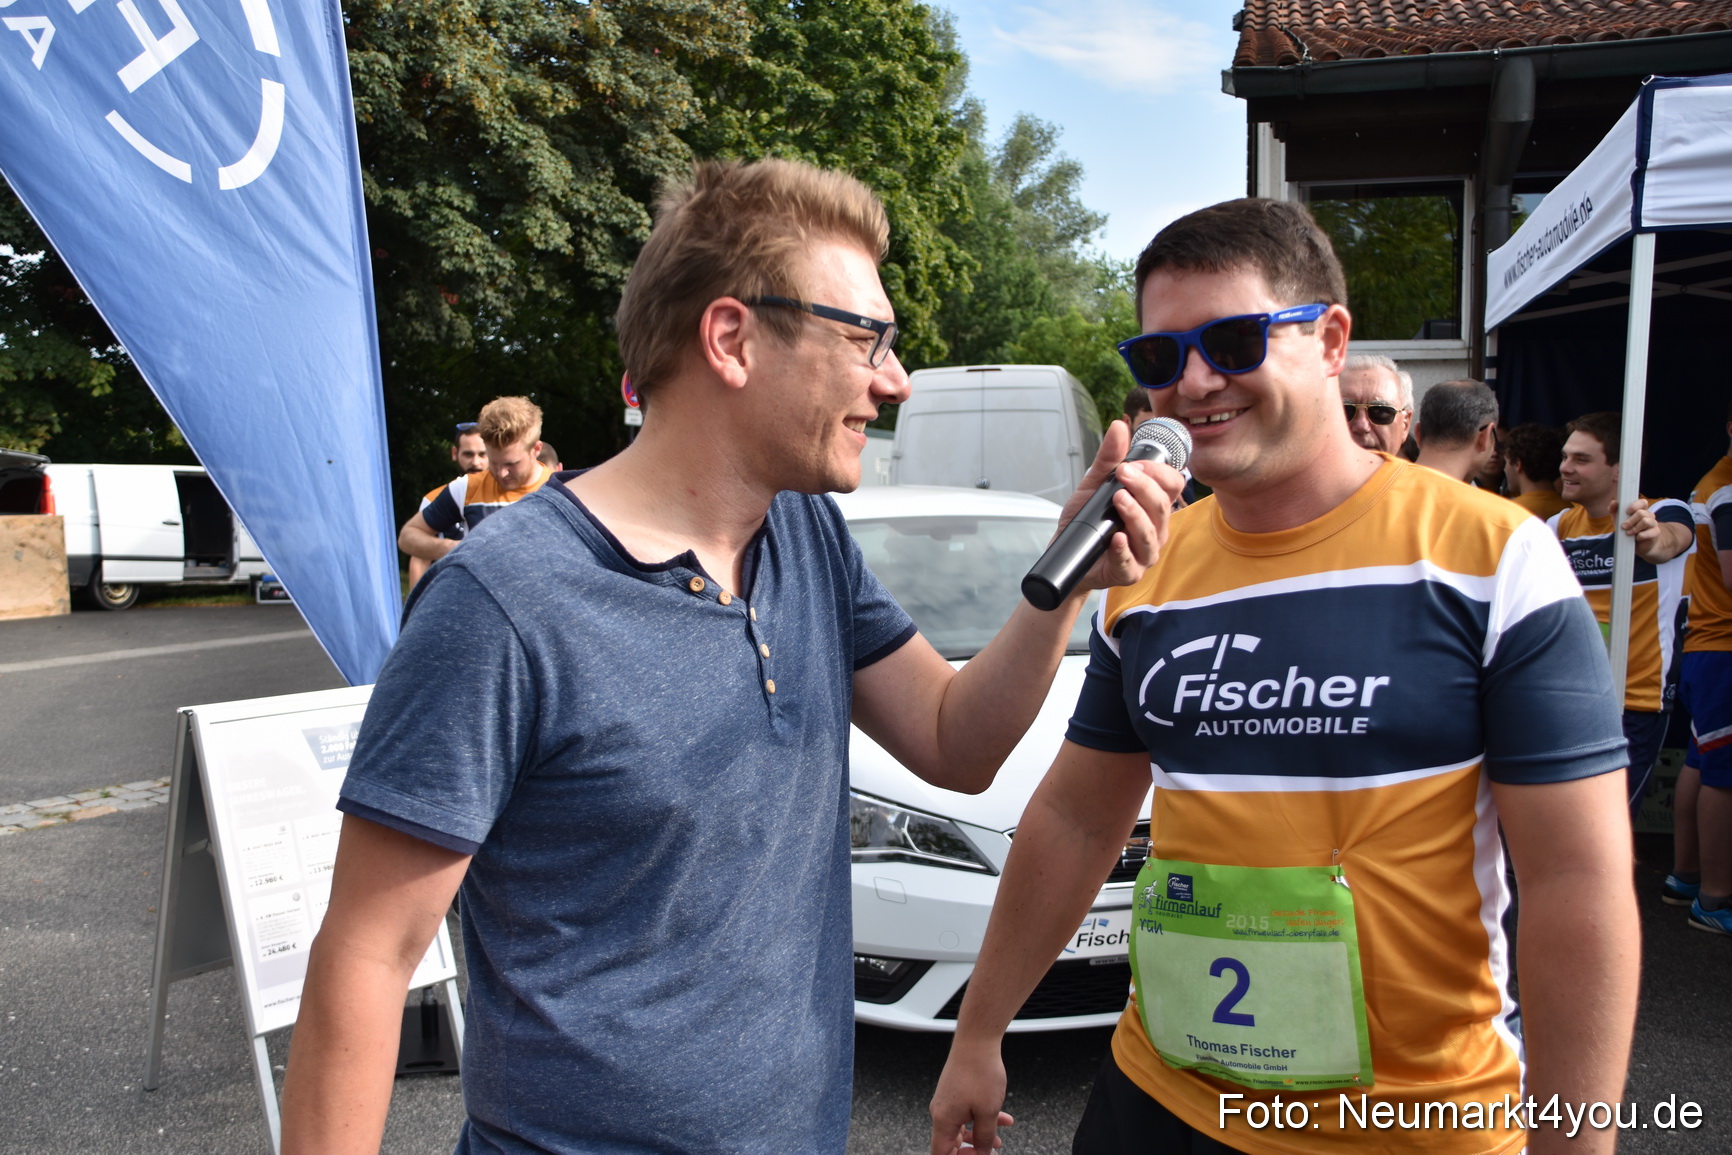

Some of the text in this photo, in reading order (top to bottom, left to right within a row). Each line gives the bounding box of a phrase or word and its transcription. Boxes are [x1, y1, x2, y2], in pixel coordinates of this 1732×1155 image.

[1503, 191, 1594, 291] www.fischer-automobile.de
[1570, 554, 1614, 570] ische
[1173, 665, 1390, 713] Fischer
[1194, 716, 1370, 736] AUTOMOBILE
[1155, 894, 1223, 918] firmenlauf
[1226, 914, 1270, 930] 2015
[1076, 928, 1131, 948] Fisch
[1208, 956, 1256, 1028] 2
[1186, 1034, 1297, 1059] Thomas Fischer
[1220, 1059, 1262, 1071] Automobile
[1263, 1064, 1288, 1072] GmbH
